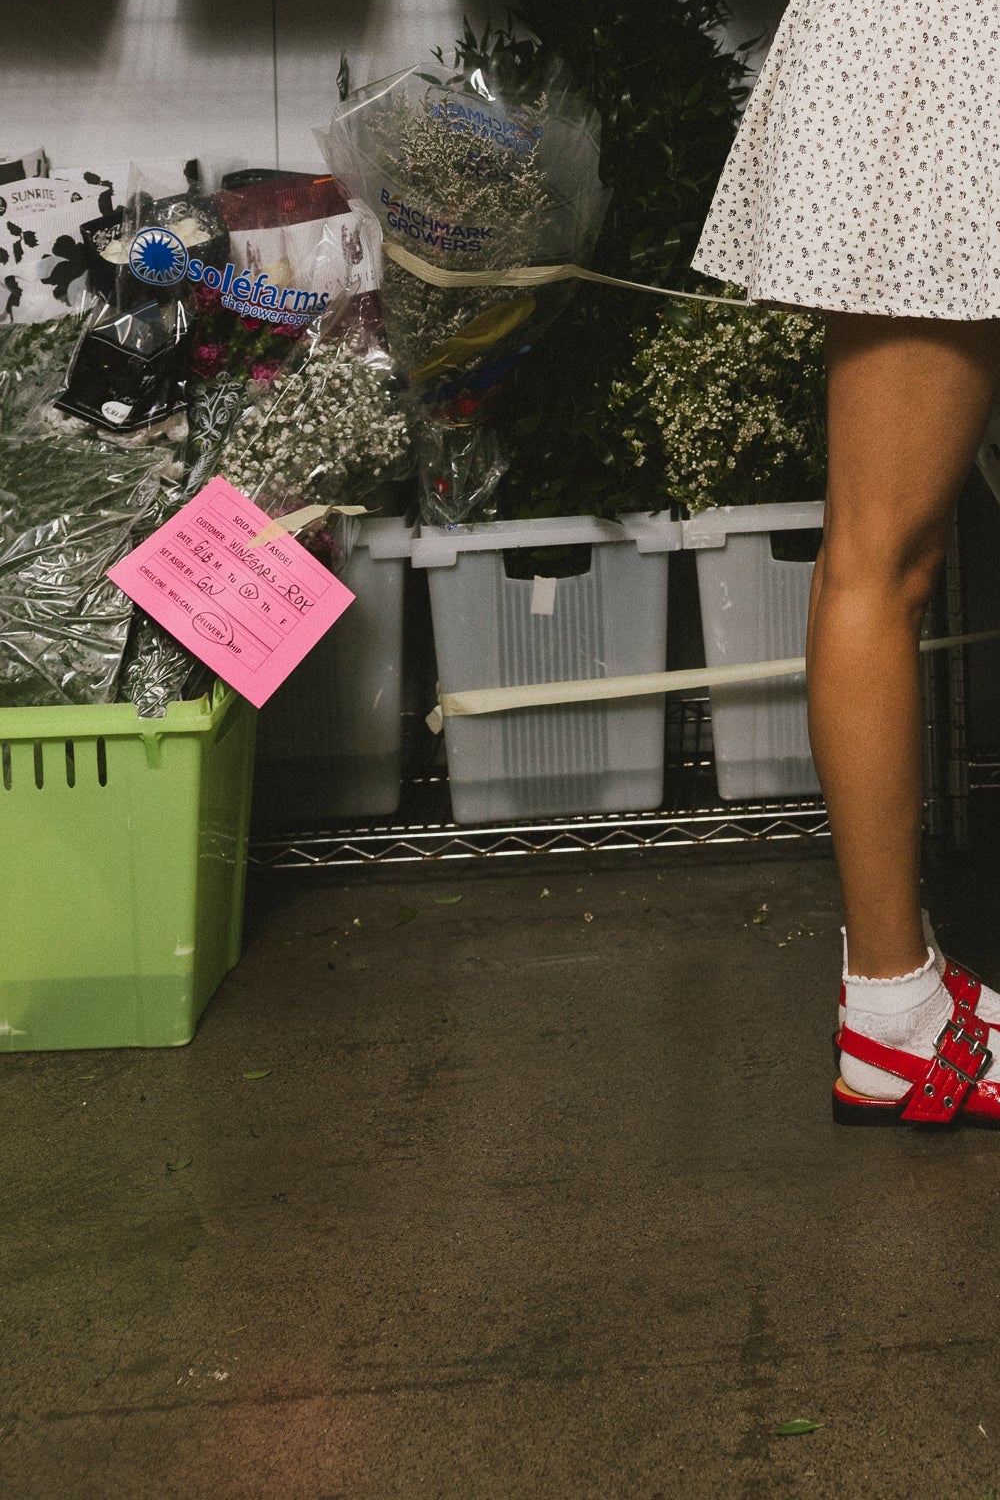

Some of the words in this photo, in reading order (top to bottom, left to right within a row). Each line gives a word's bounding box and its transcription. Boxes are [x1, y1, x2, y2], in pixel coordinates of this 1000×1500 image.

[11, 188, 56, 204] SUNRITE
[381, 188, 494, 239] BENCHMARK
[387, 211, 482, 252] GROWERS
[187, 259, 330, 313] soléfarms
[196, 516, 227, 543] CUSTOMER:
[232, 515, 250, 535] SOLD
[267, 545, 293, 567] ASIDE!
[158, 547, 173, 562] SET
[170, 555, 187, 572] ASIDE
[183, 566, 195, 580] BY:
[193, 540, 211, 565] 6/18
[176, 531, 194, 548] DATE:
[213, 560, 223, 571] M
[227, 572, 237, 583] Tu
[244, 586, 253, 598] W
[260, 602, 271, 614] Th
[280, 618, 287, 627] F
[196, 576, 226, 596] GN
[139, 565, 156, 584] CIRCLE
[153, 577, 168, 591] ONE:
[167, 588, 194, 615] WILL-CALL
[196, 614, 226, 641] DELIVERY
